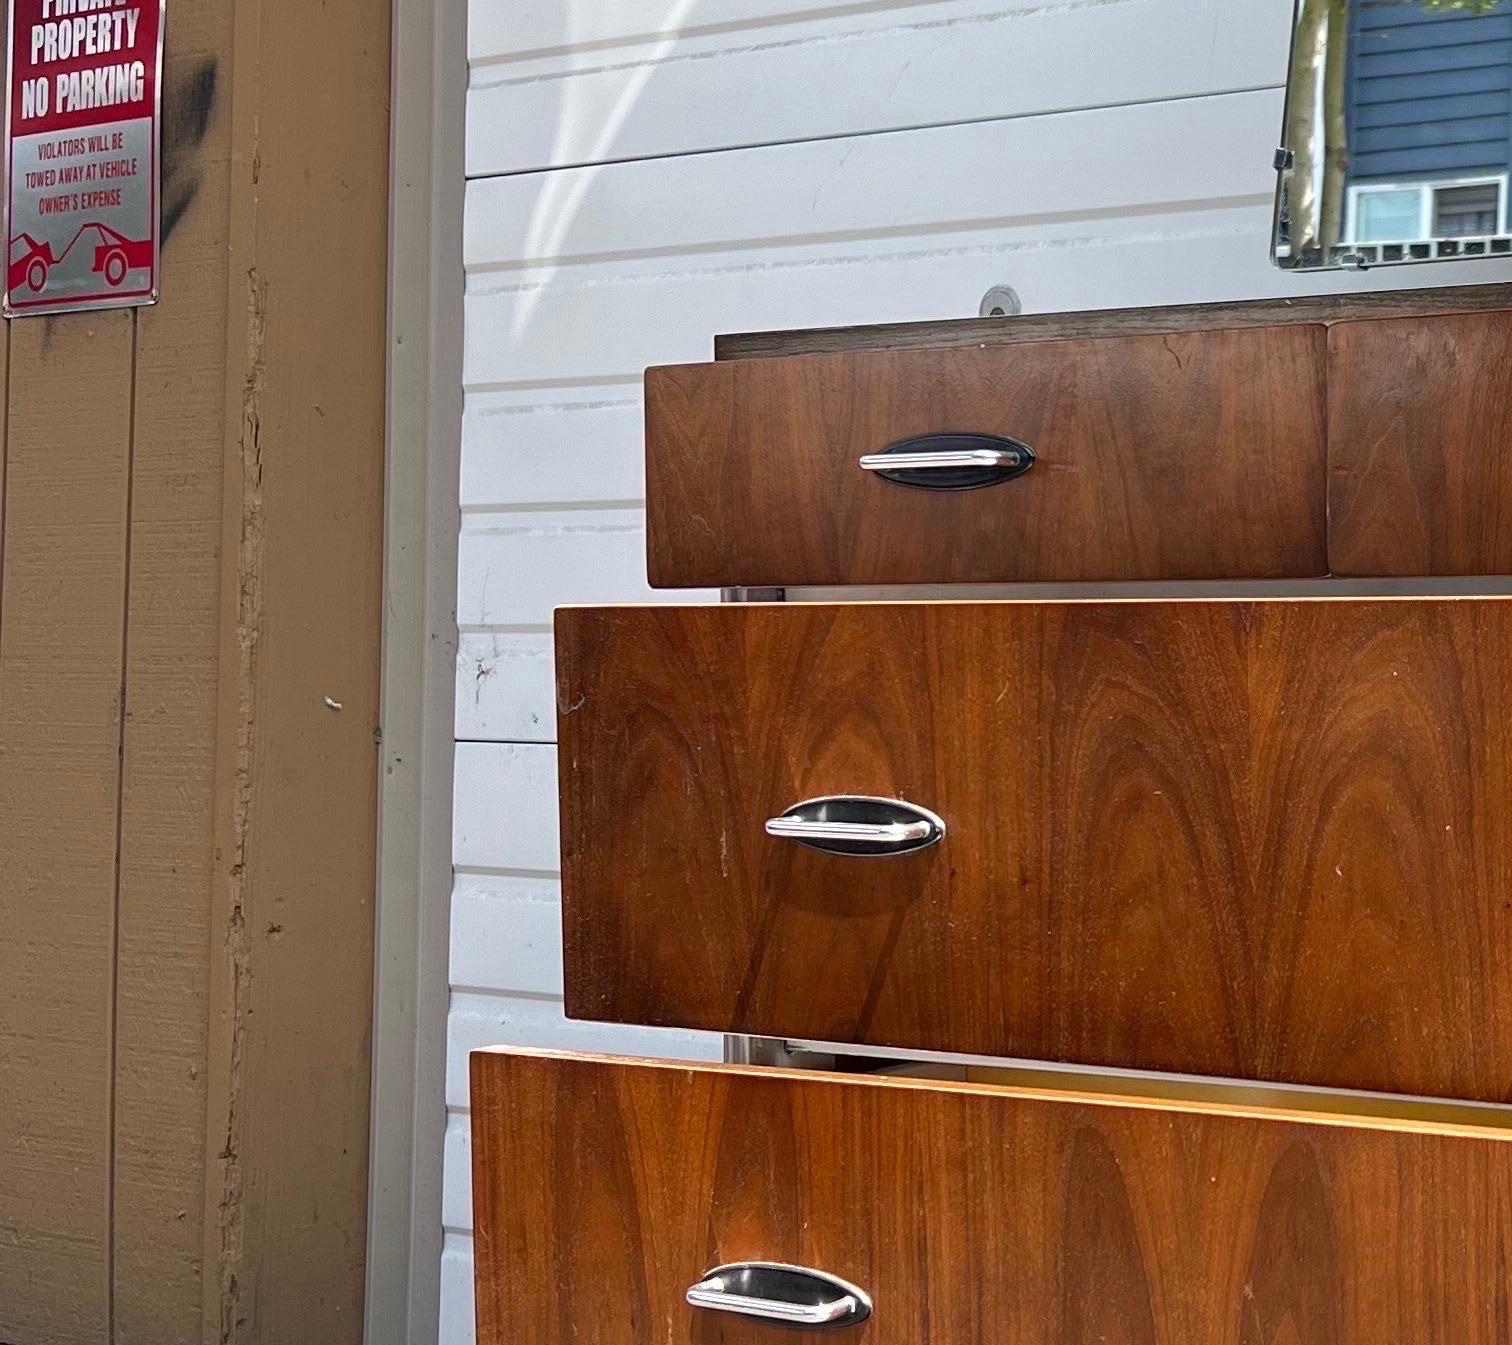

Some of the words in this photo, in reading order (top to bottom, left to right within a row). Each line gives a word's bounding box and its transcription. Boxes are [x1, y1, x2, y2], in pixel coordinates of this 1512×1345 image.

[31, 8, 141, 65] PROPERTY
[21, 76, 49, 120] NO
[56, 60, 145, 114] PARKING
[38, 138, 85, 160] VIOLATORS
[88, 134, 110, 153] WILL
[112, 132, 123, 149] BE
[26, 169, 56, 189] TOWED
[58, 165, 84, 185] AWAY
[86, 163, 98, 181] AT
[99, 158, 138, 179] VEHICLE
[38, 194, 79, 215] OWNER'S
[81, 189, 122, 210] EXPENSE
